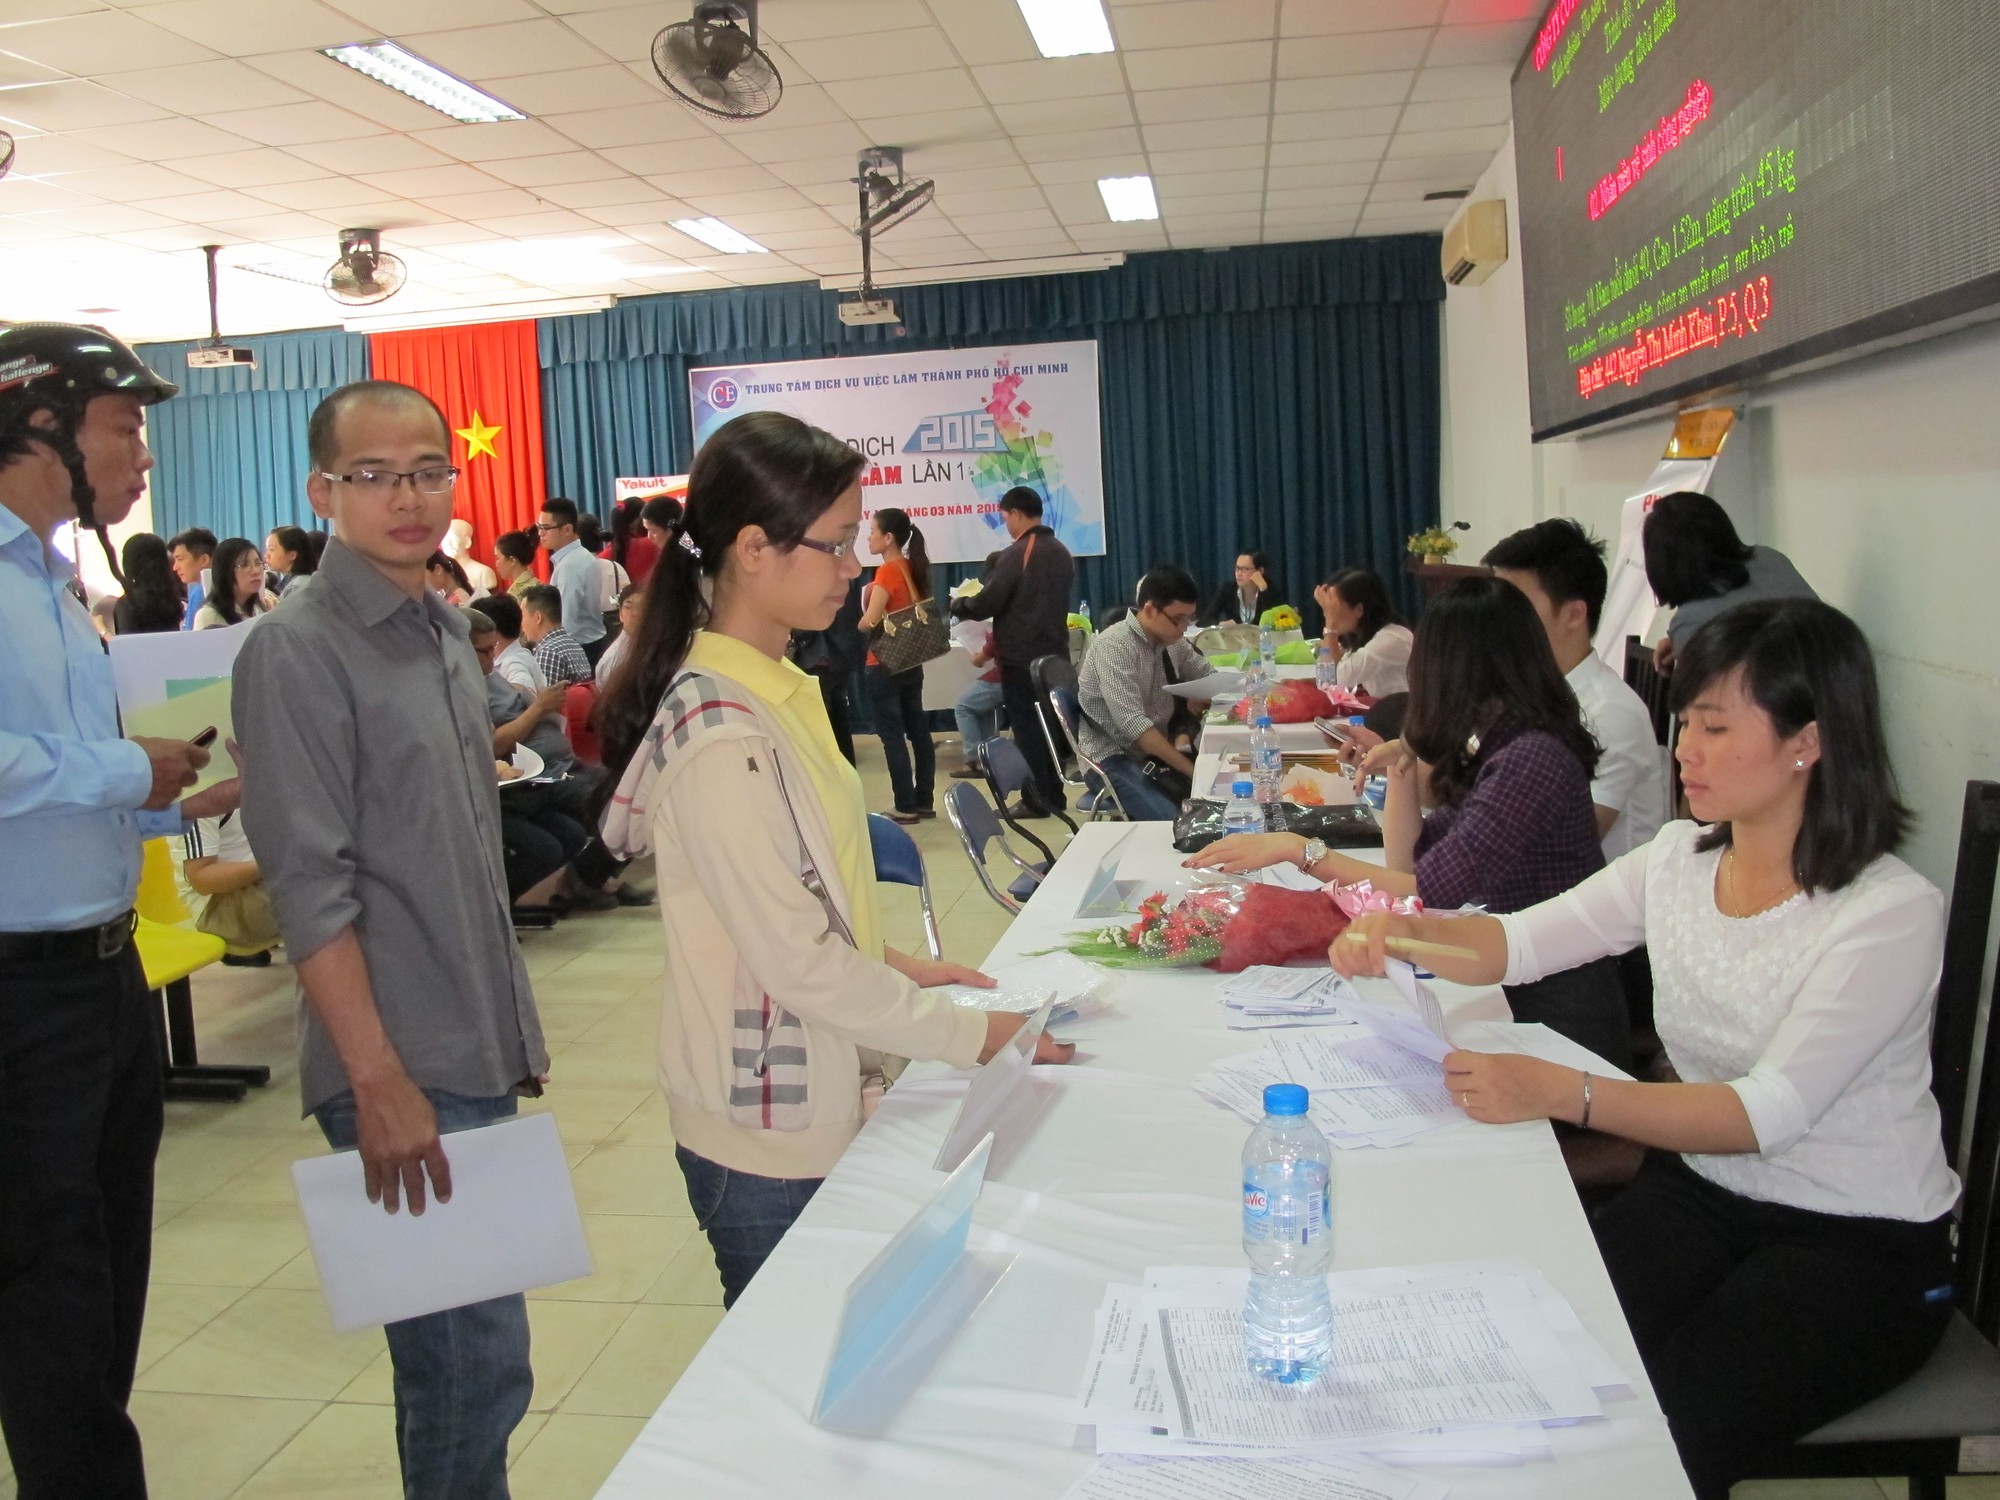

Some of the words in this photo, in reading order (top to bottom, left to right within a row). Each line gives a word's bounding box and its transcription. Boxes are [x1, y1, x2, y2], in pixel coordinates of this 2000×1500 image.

[1653, 237, 1671, 270] Cao
[1756, 151, 1774, 198] 45
[1777, 144, 1796, 192] kg
[1662, 315, 1688, 360] Minh
[0, 358, 26, 371] ange
[0, 364, 50, 382] hallenge
[745, 383, 783, 395] TRUNG
[786, 379, 811, 392] TÂM
[814, 378, 841, 392] DỊCH
[845, 377, 859, 390] VỤ
[863, 373, 890, 388] VIỆC
[893, 371, 918, 384] LÀM
[922, 369, 961, 382] THÀNH
[966, 365, 990, 379] PHỐ
[1038, 362, 1069, 374] MINH
[920, 413, 997, 452] 2015
[621, 478, 668, 490] Yakult
[912, 458, 951, 484] LẦN
[956, 461, 965, 481] 1
[903, 505, 929, 518] ÁNG
[930, 506, 945, 517] 03
[947, 502, 973, 516] NĂM
